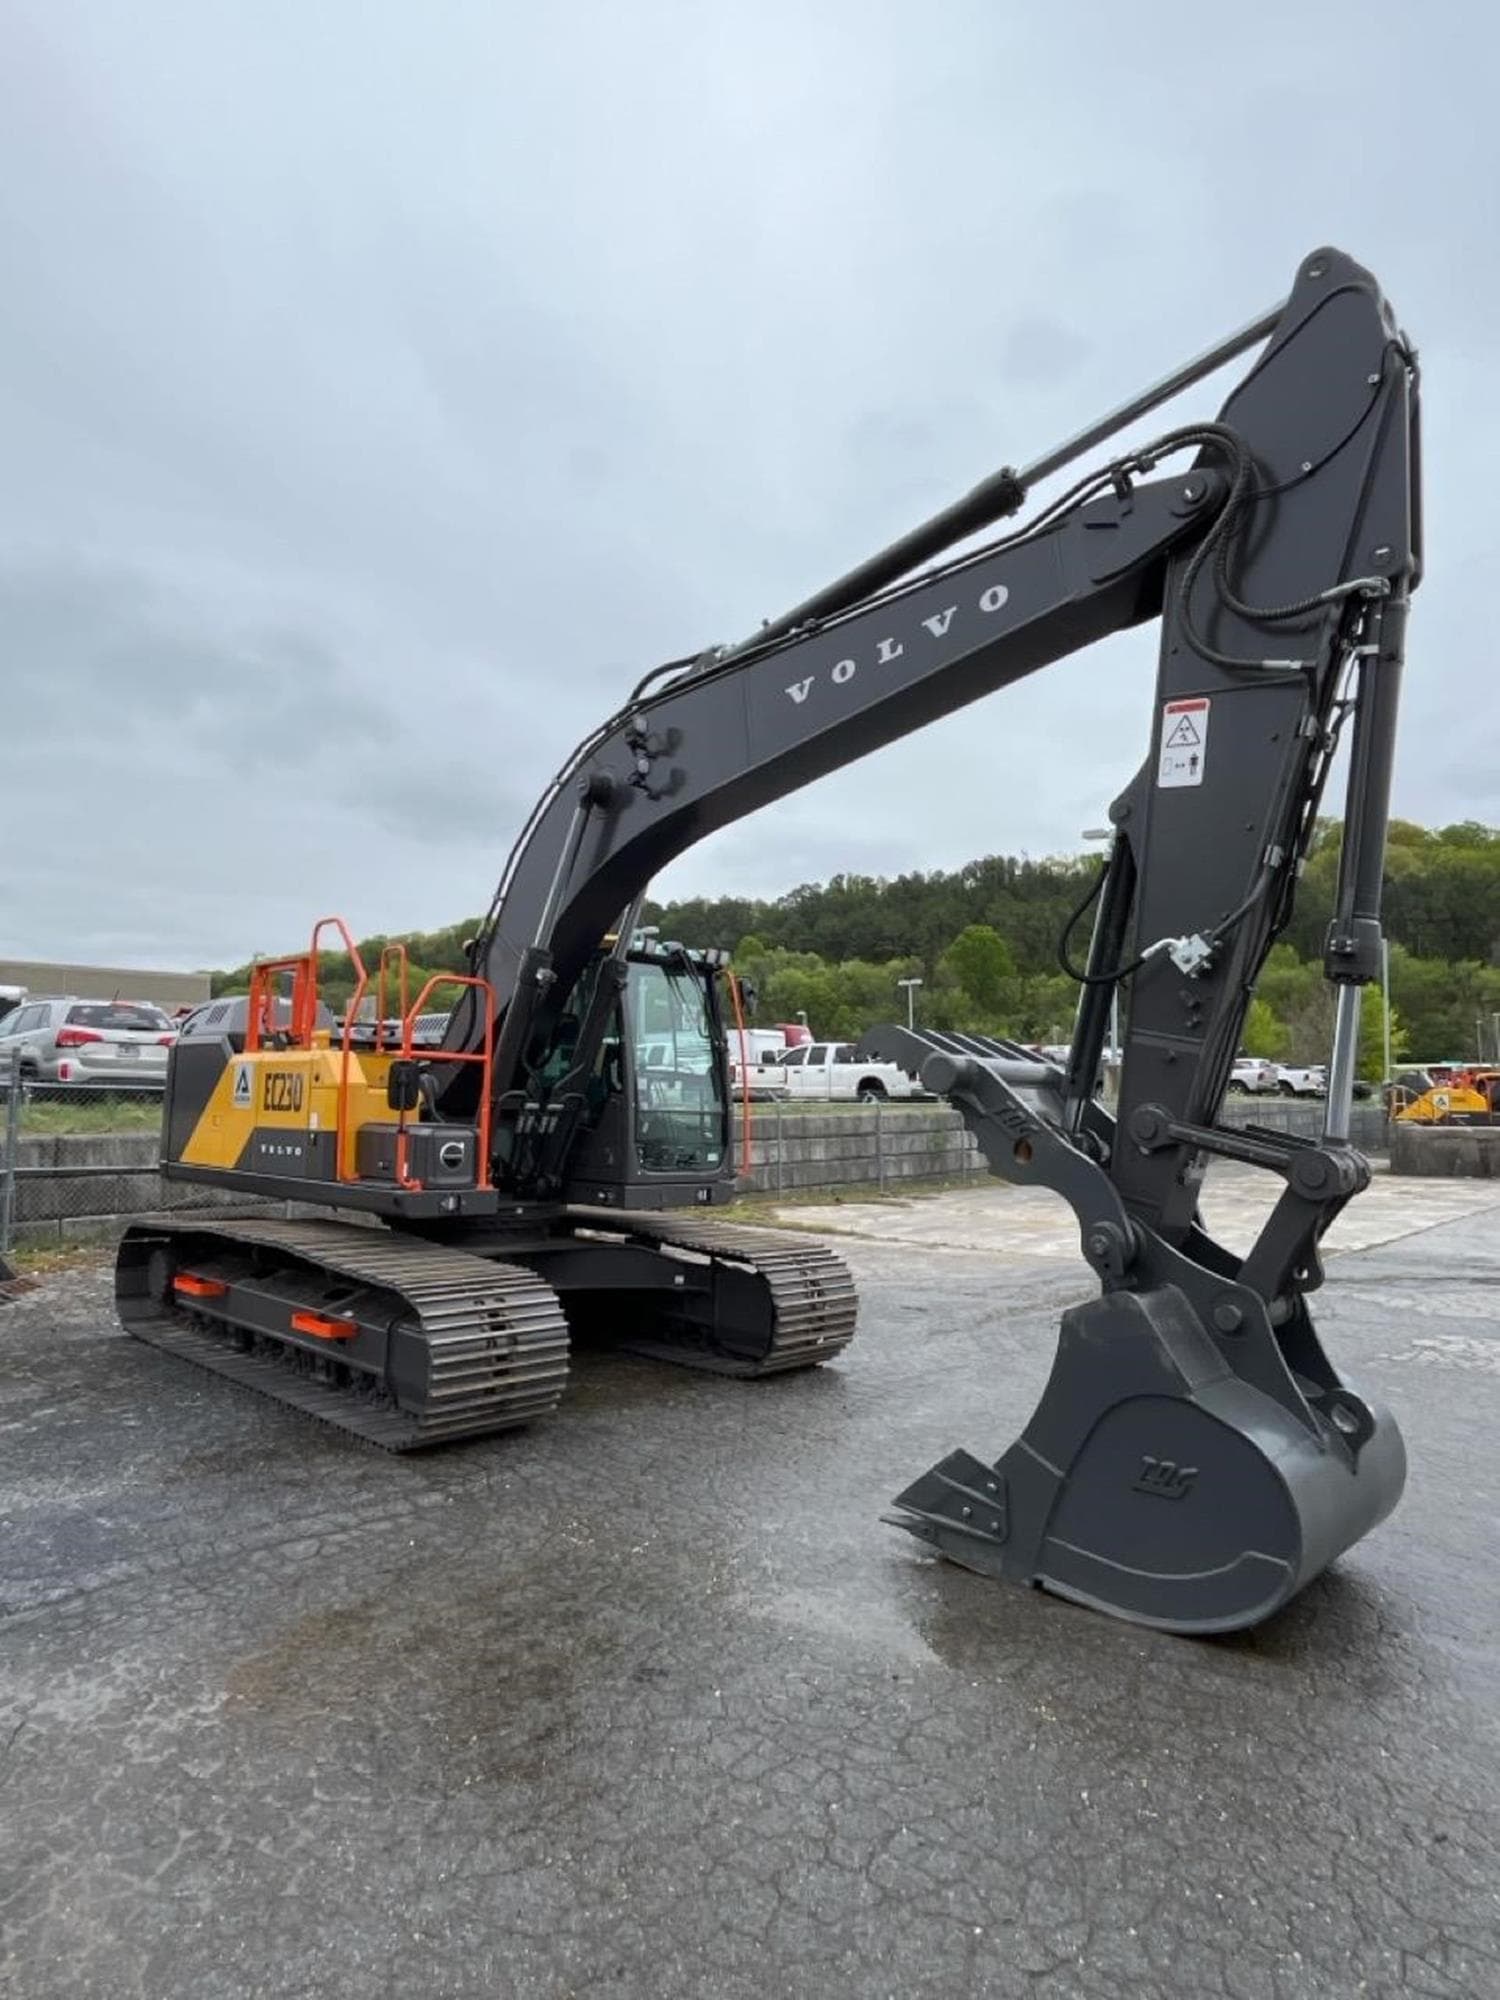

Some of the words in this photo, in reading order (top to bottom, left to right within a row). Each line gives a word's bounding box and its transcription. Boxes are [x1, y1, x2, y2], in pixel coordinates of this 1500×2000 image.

[785, 584, 1009, 704] VOLVO
[263, 1072, 304, 1112] EC230
[260, 1143, 302, 1156] VOLVO
